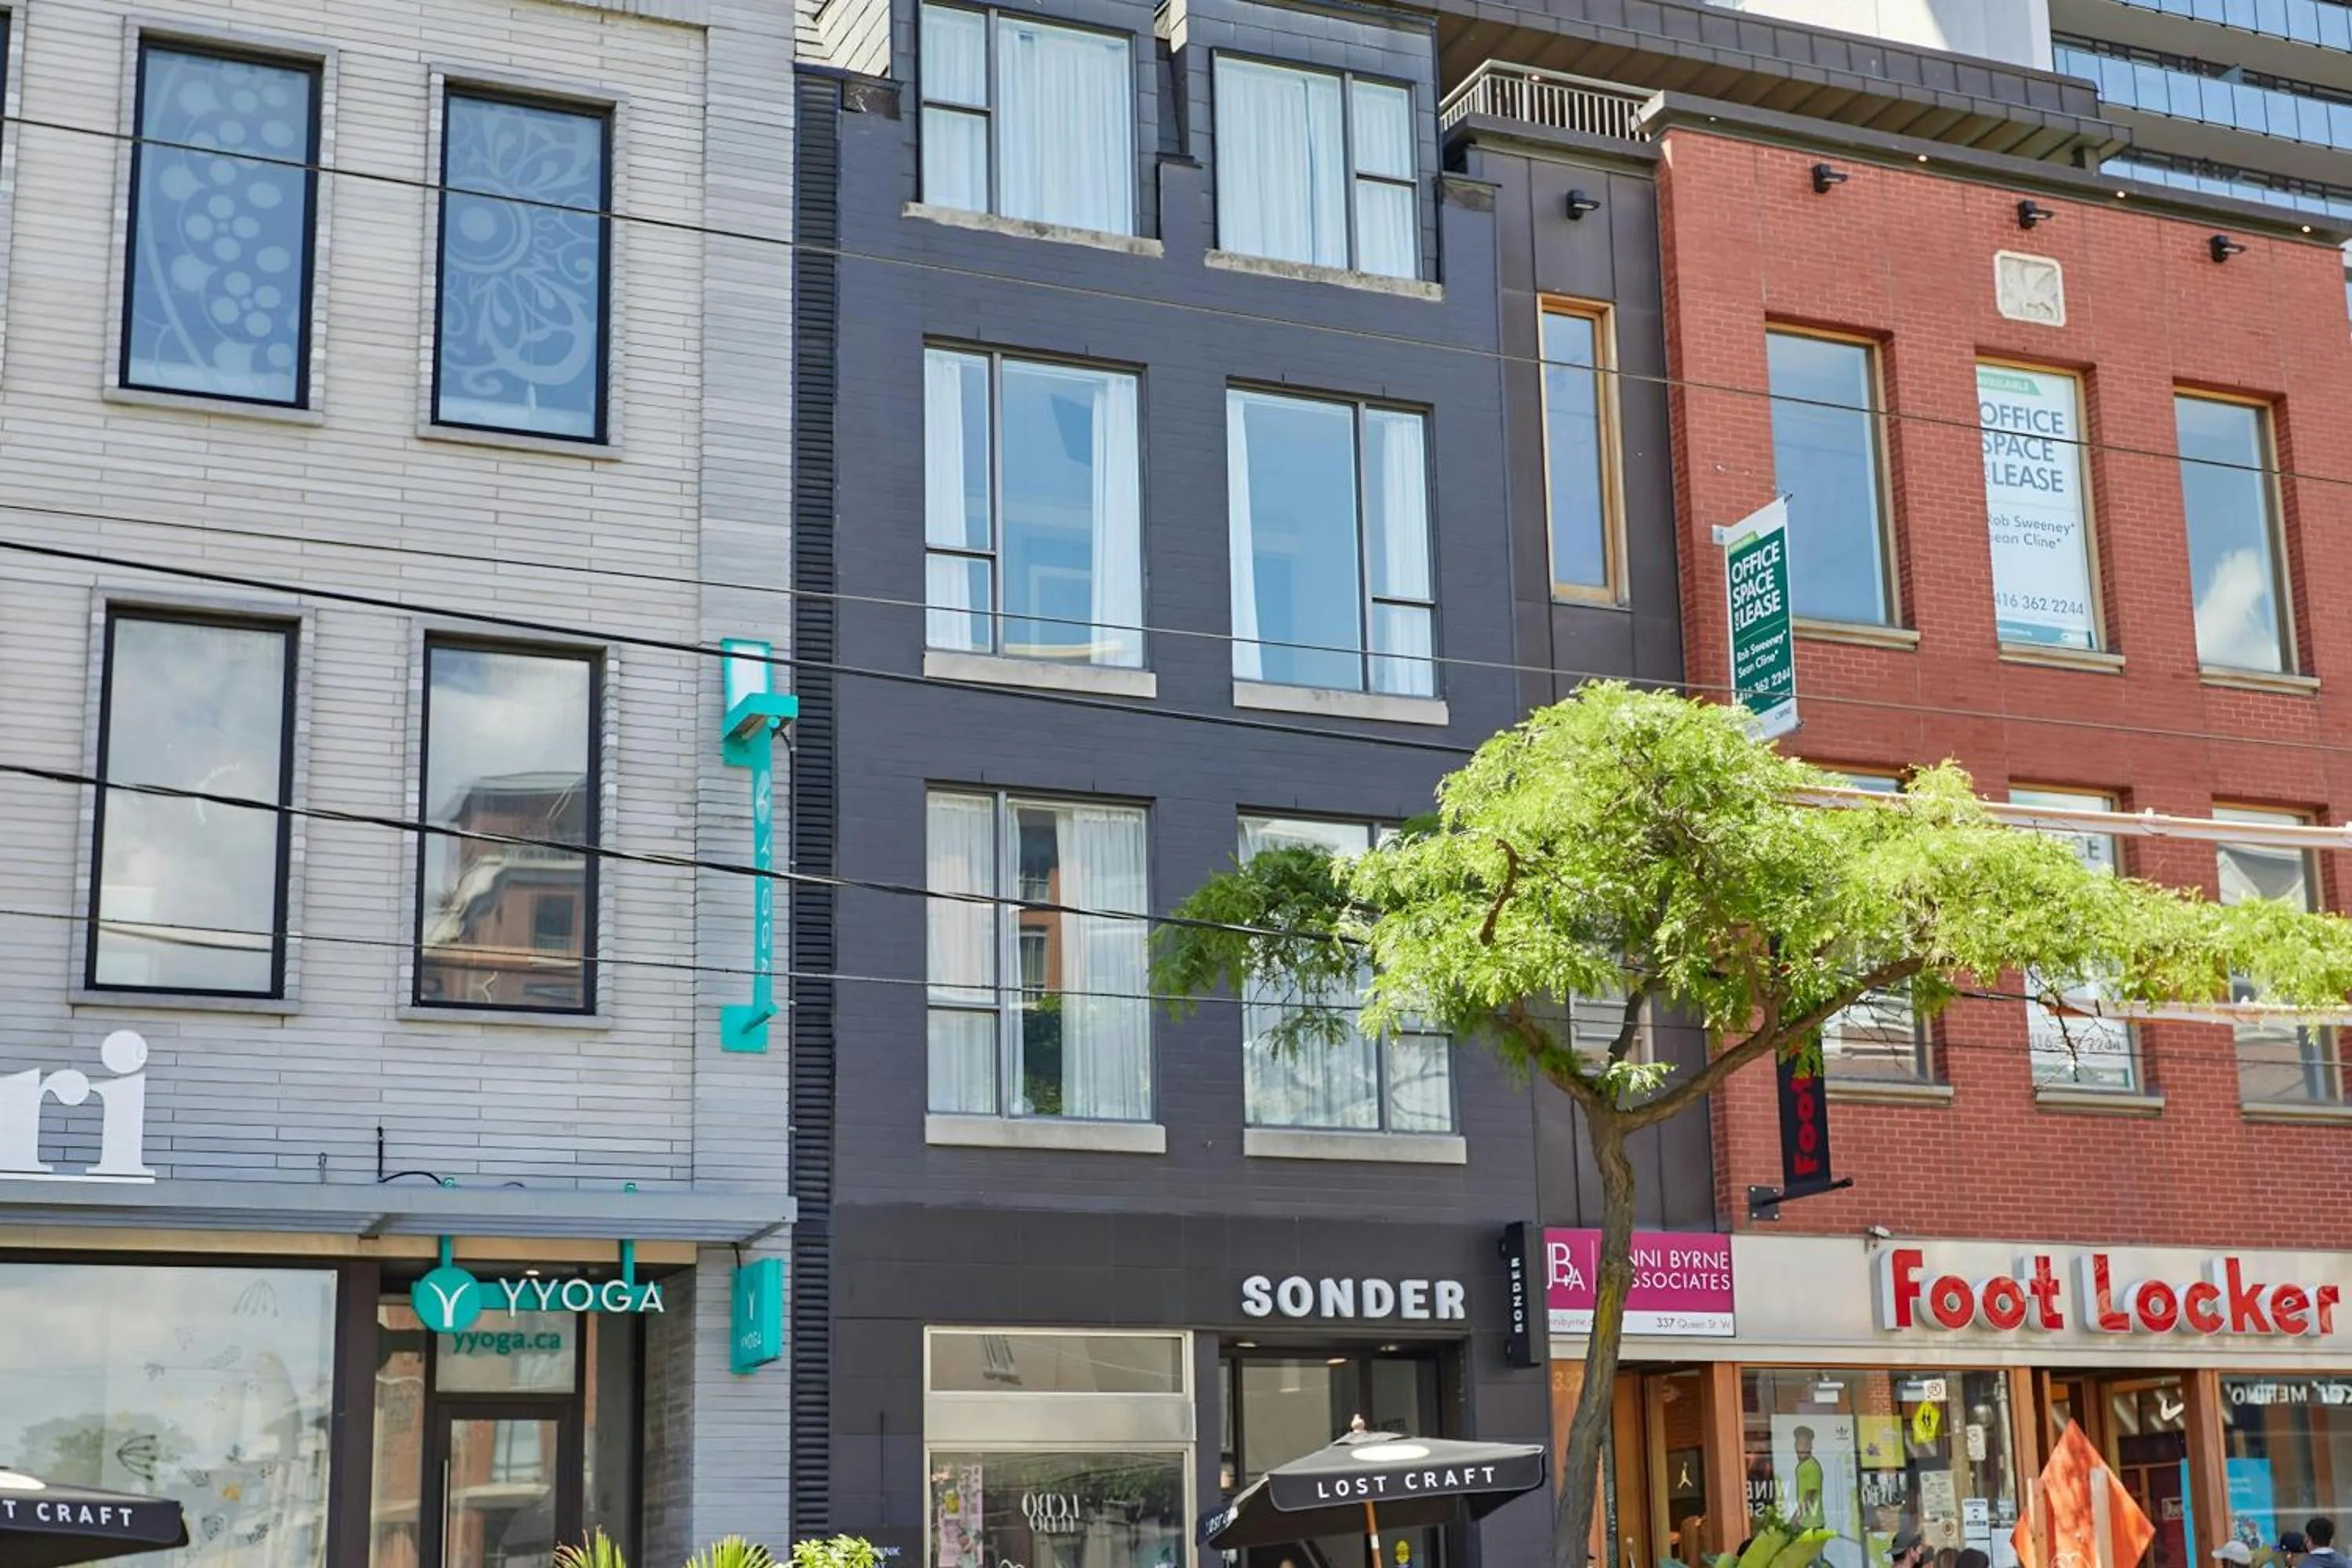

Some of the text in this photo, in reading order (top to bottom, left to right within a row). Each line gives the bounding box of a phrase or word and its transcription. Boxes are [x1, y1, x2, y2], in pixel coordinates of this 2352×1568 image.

[1980, 401, 2064, 434] OFFICE
[1992, 462, 2063, 492] LEASE
[1992, 534, 2019, 544] ean
[1732, 540, 1780, 583] OFFICE
[1733, 568, 1774, 608] SPACE
[1740, 590, 1781, 628] LEASE
[2022, 595, 2047, 611] 362
[2052, 599, 2083, 615] 2244
[1670, 1250, 1730, 1269] BYRNE
[499, 1278, 665, 1317] YYOGA
[1242, 1276, 1465, 1319] SONDER
[1511, 1257, 1523, 1333] SONDER
[1886, 1248, 2341, 1335] Foot Locker
[1657, 1317, 1675, 1328] 337
[453, 1330, 561, 1356] yyoga.ca
[1317, 1467, 1495, 1498] LOST CRAFT
[36, 1501, 134, 1528] CRAFT
